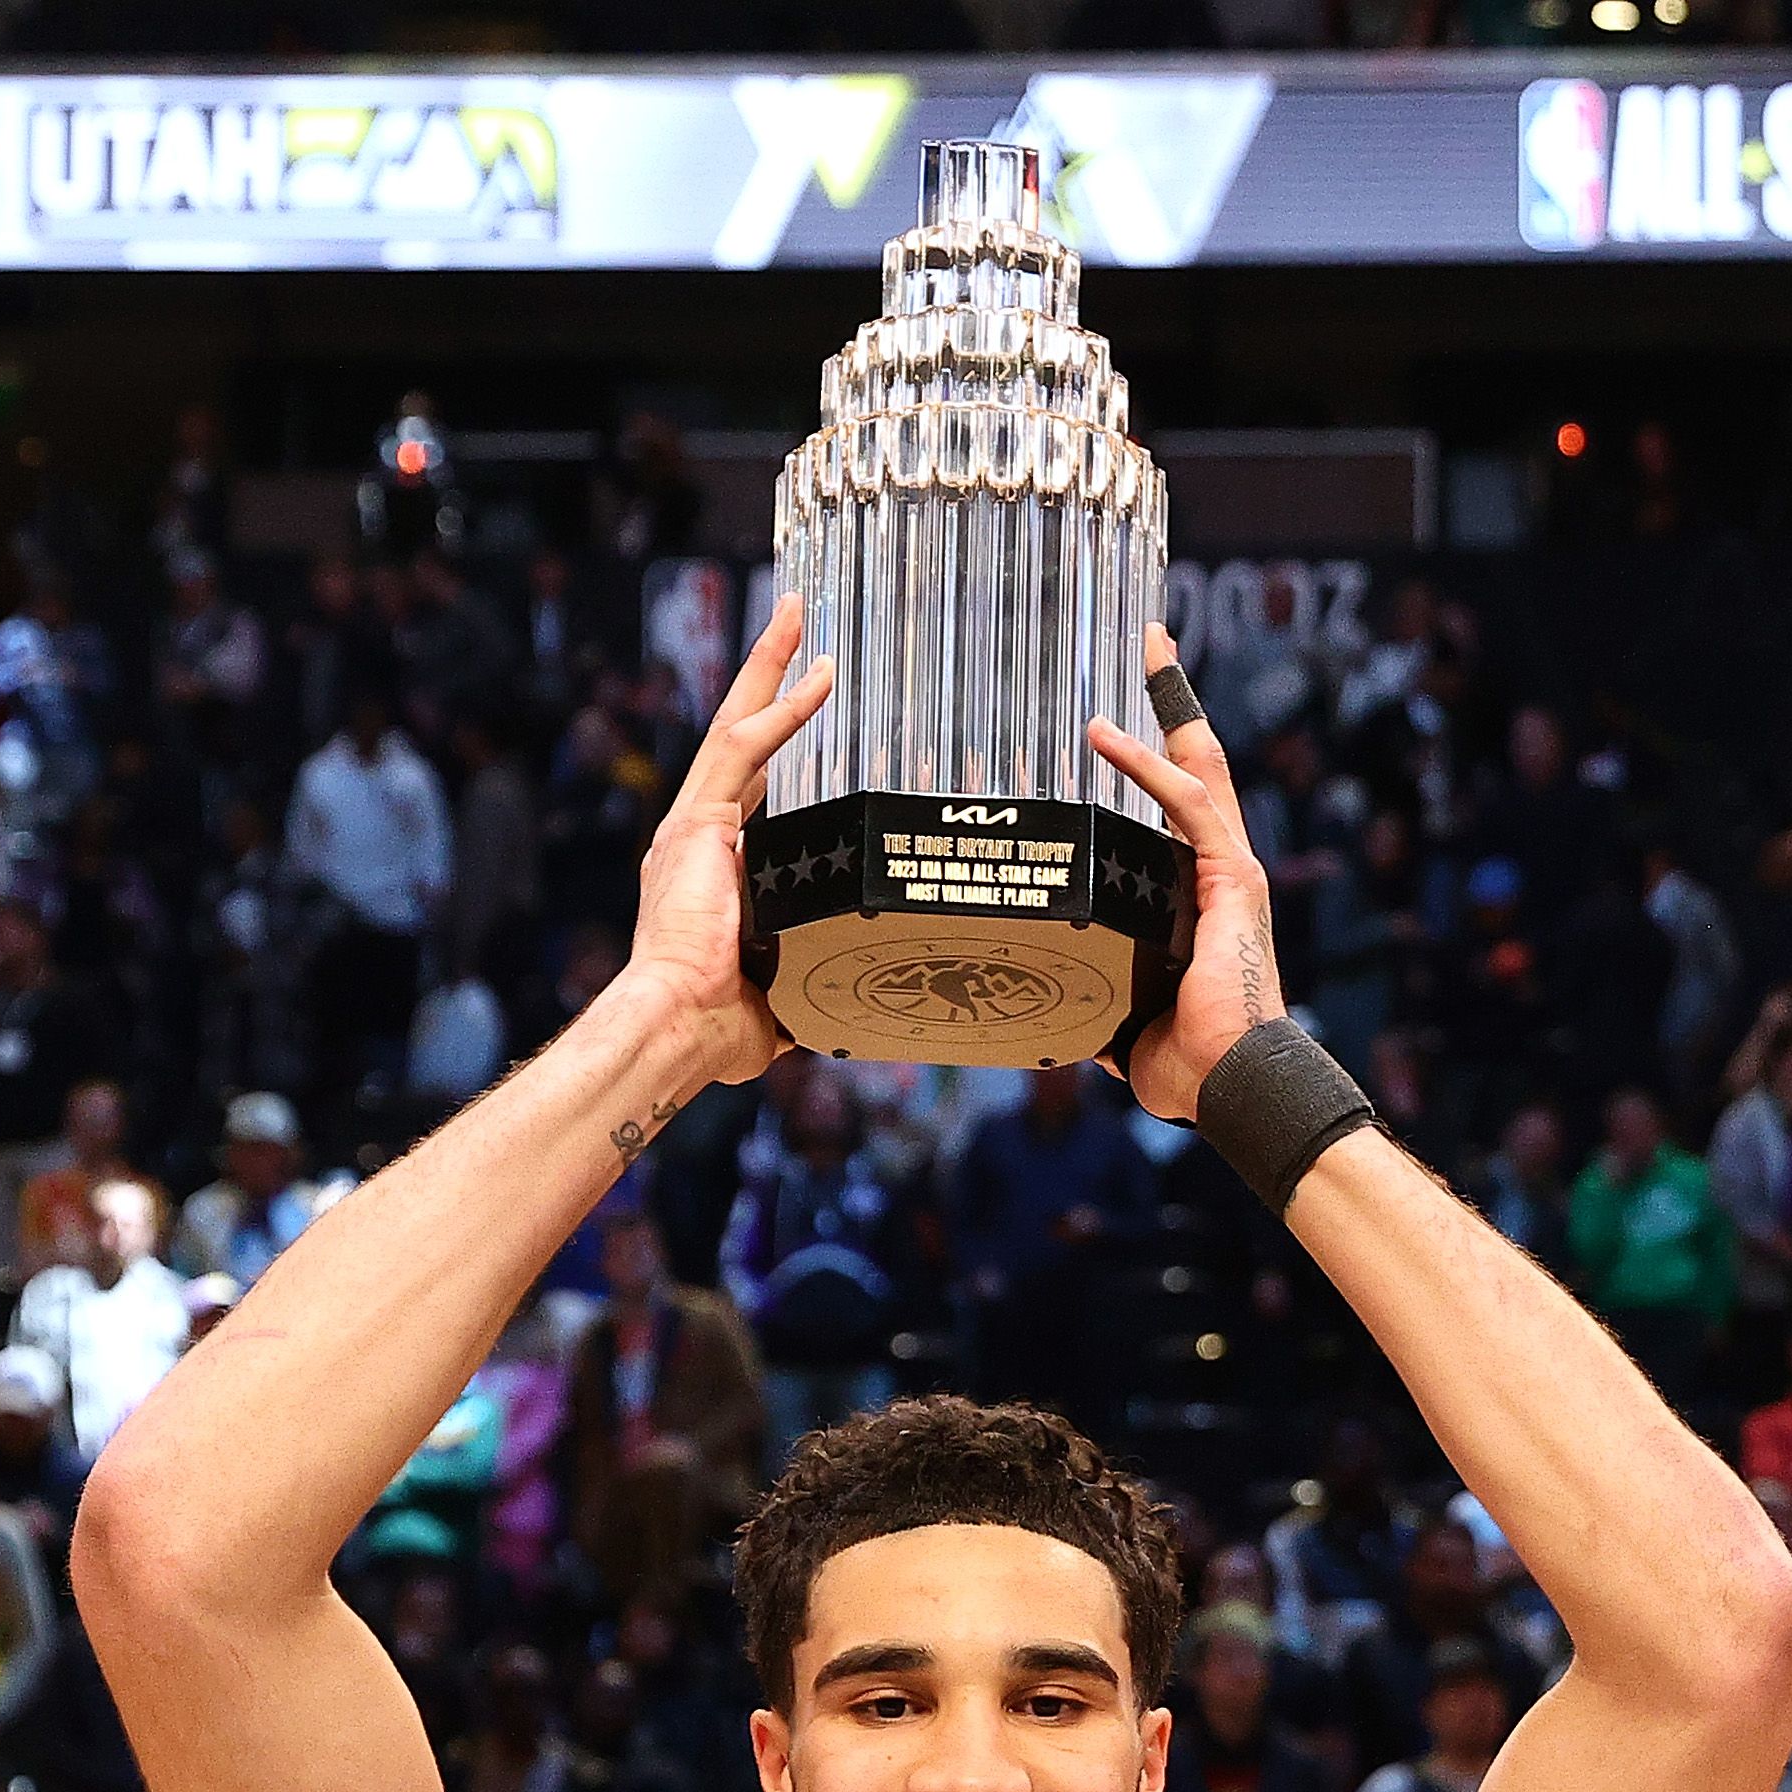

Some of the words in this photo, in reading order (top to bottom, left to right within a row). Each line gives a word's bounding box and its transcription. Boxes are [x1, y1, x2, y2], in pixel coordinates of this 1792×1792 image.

[30, 106, 280, 212] UTAH
[942, 805, 1017, 824] KIA
[883, 833, 911, 854] THE
[915, 835, 953, 856] KOBE
[957, 837, 1014, 859] BRYANT
[1018, 841, 1074, 863] TROPHY
[887, 860, 918, 878] 2023
[921, 861, 942, 880] KIA
[945, 862, 969, 881] NBA
[972, 863, 1030, 884] ALL-STAR
[1033, 867, 1069, 886] GAME
[906, 883, 939, 901] MOST
[942, 884, 1001, 905] VALUABLE
[1004, 887, 1049, 907] PLAYER
